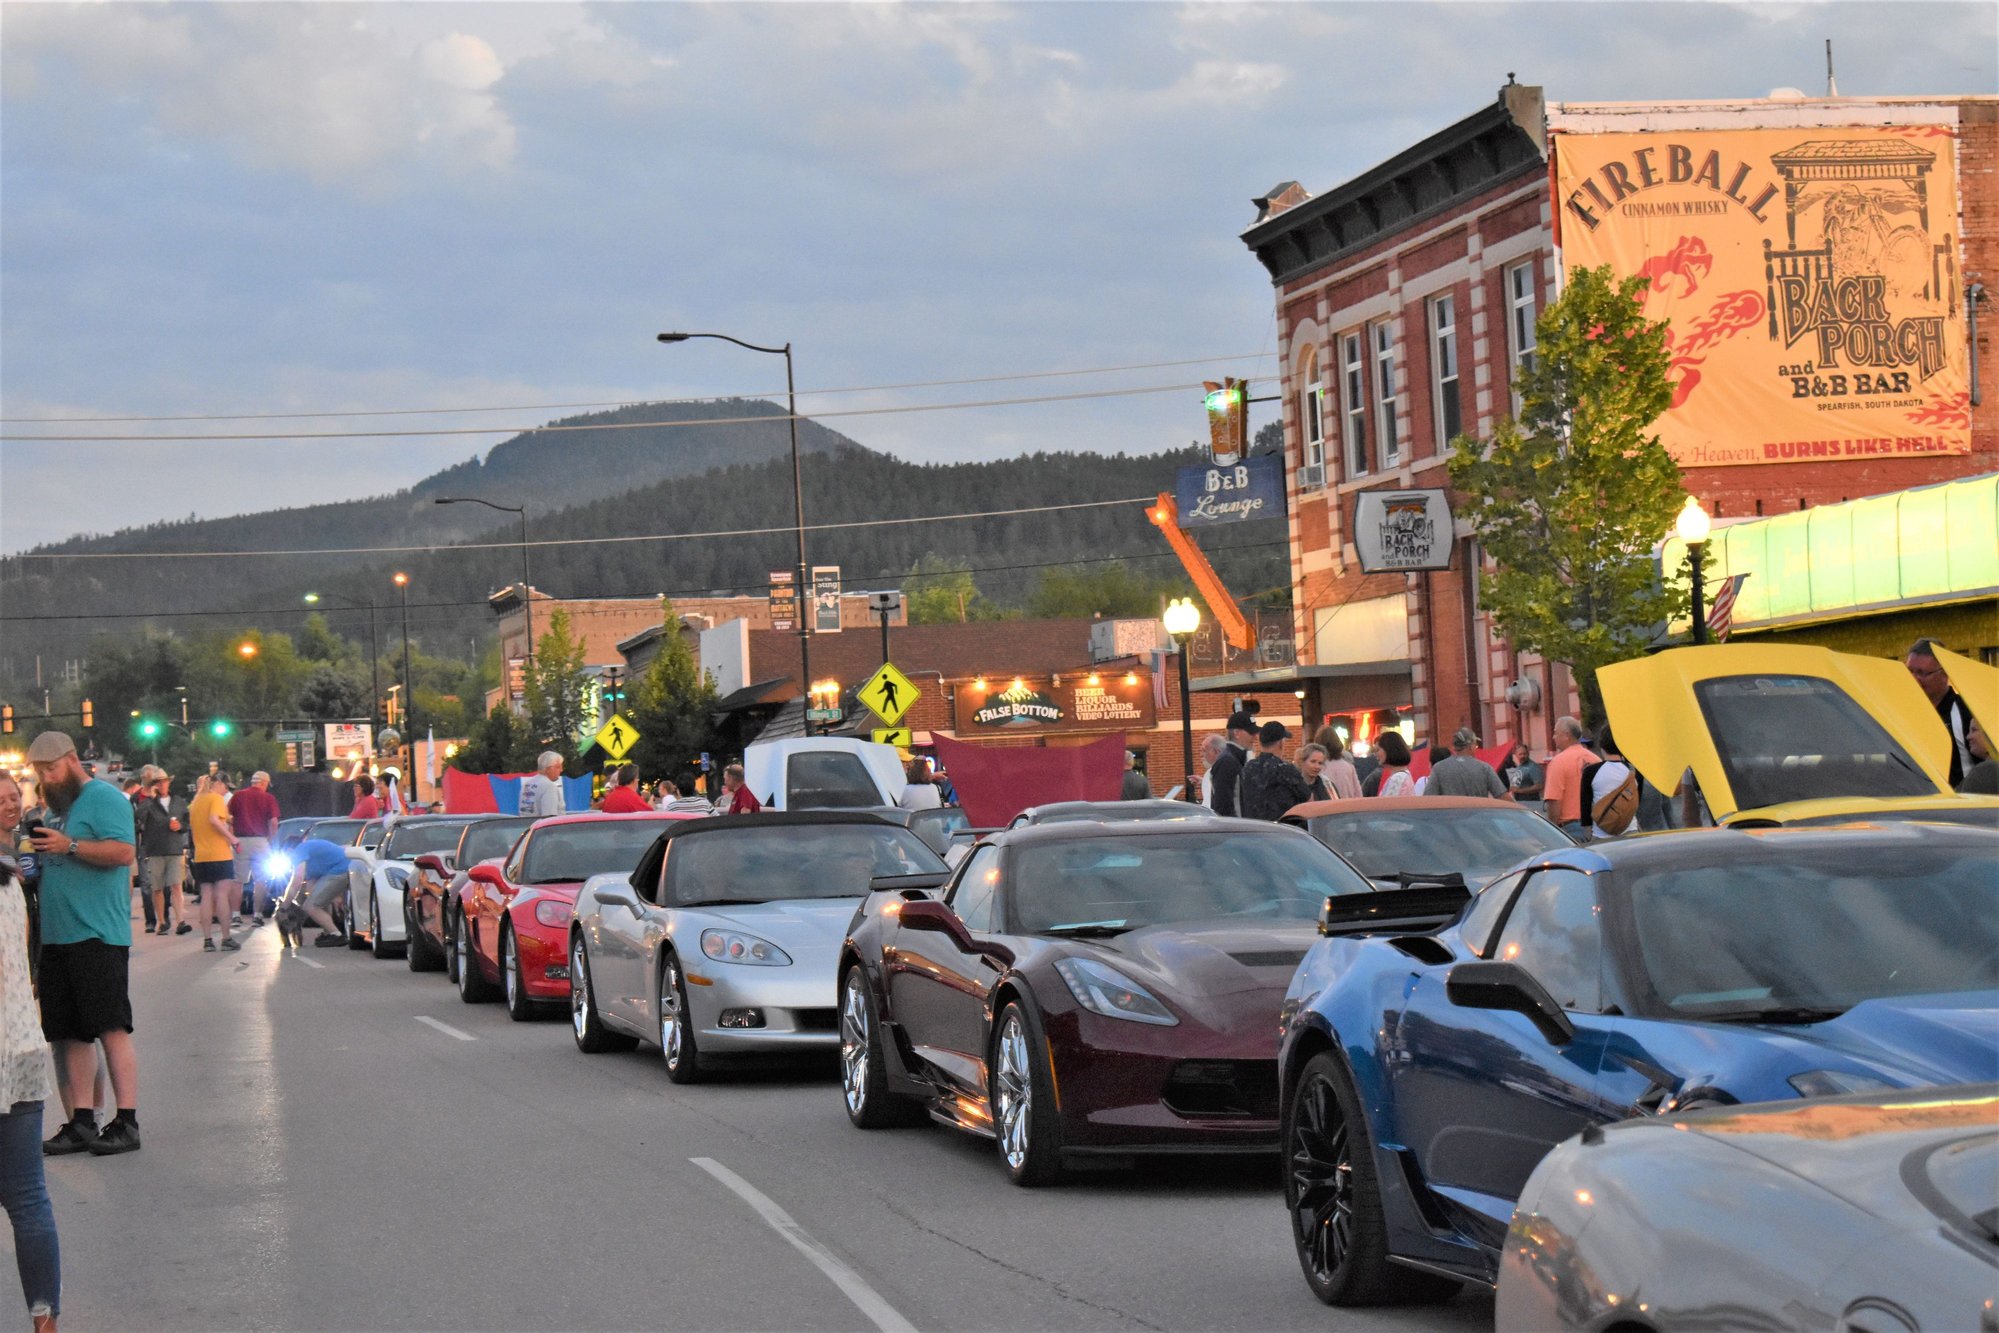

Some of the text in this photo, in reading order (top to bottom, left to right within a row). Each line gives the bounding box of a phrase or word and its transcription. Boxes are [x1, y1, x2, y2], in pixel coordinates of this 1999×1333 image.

[1565, 144, 1781, 234] FIREBALL
[1622, 200, 1729, 217] CINNAMON WHISKY
[1776, 275, 1892, 350] BACK
[1817, 316, 1948, 384] PORCH
[1778, 360, 1815, 377] and
[1791, 371, 1912, 399] B&B BAR
[1817, 398, 1924, 412] SPEARFISH, SOUTH DAKOTA
[1690, 441, 1760, 463] Heaven,
[1763, 440, 1841, 459] BURNS
[1844, 438, 1893, 455] LIKE
[1896, 435, 1948, 452] HELL
[1189, 495, 1262, 519] Lounge
[1385, 533, 1414, 552] BACK
[1395, 545, 1430, 561] PORCH
[1075, 688, 1105, 697] BEER
[1075, 695, 1117, 705] LIQUOR
[979, 703, 1059, 723] FALSE BOTTOM
[1075, 702, 1134, 713] BILLIARDS
[1076, 710, 1142, 720] VIDEO LOTTERY
